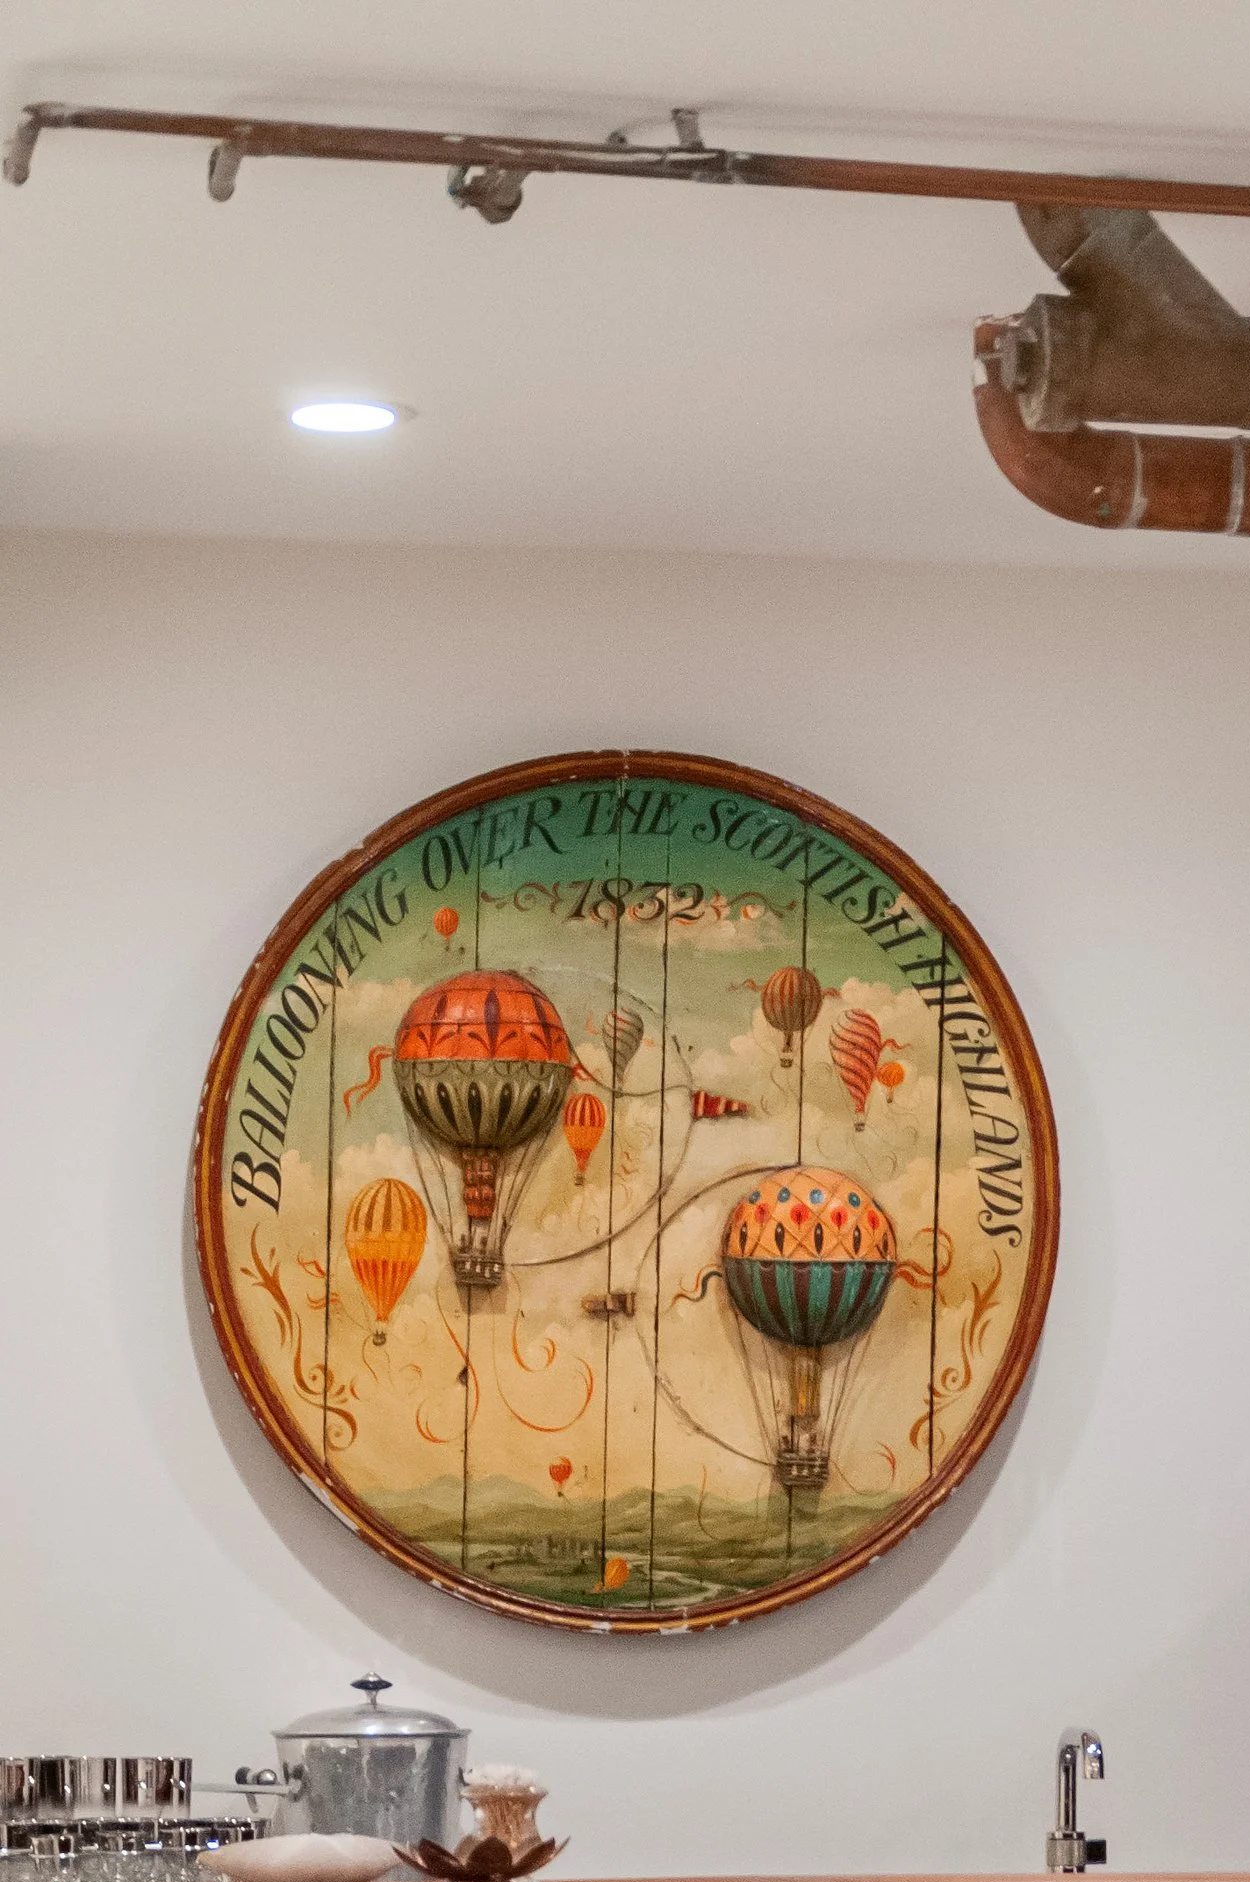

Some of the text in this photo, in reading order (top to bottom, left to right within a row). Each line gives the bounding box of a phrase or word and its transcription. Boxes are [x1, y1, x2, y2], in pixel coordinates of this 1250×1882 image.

[231, 788, 1023, 1249] BALLOONING OVER THE SCOTTISH HIGHLANDS
[567, 877, 705, 922] 1832
